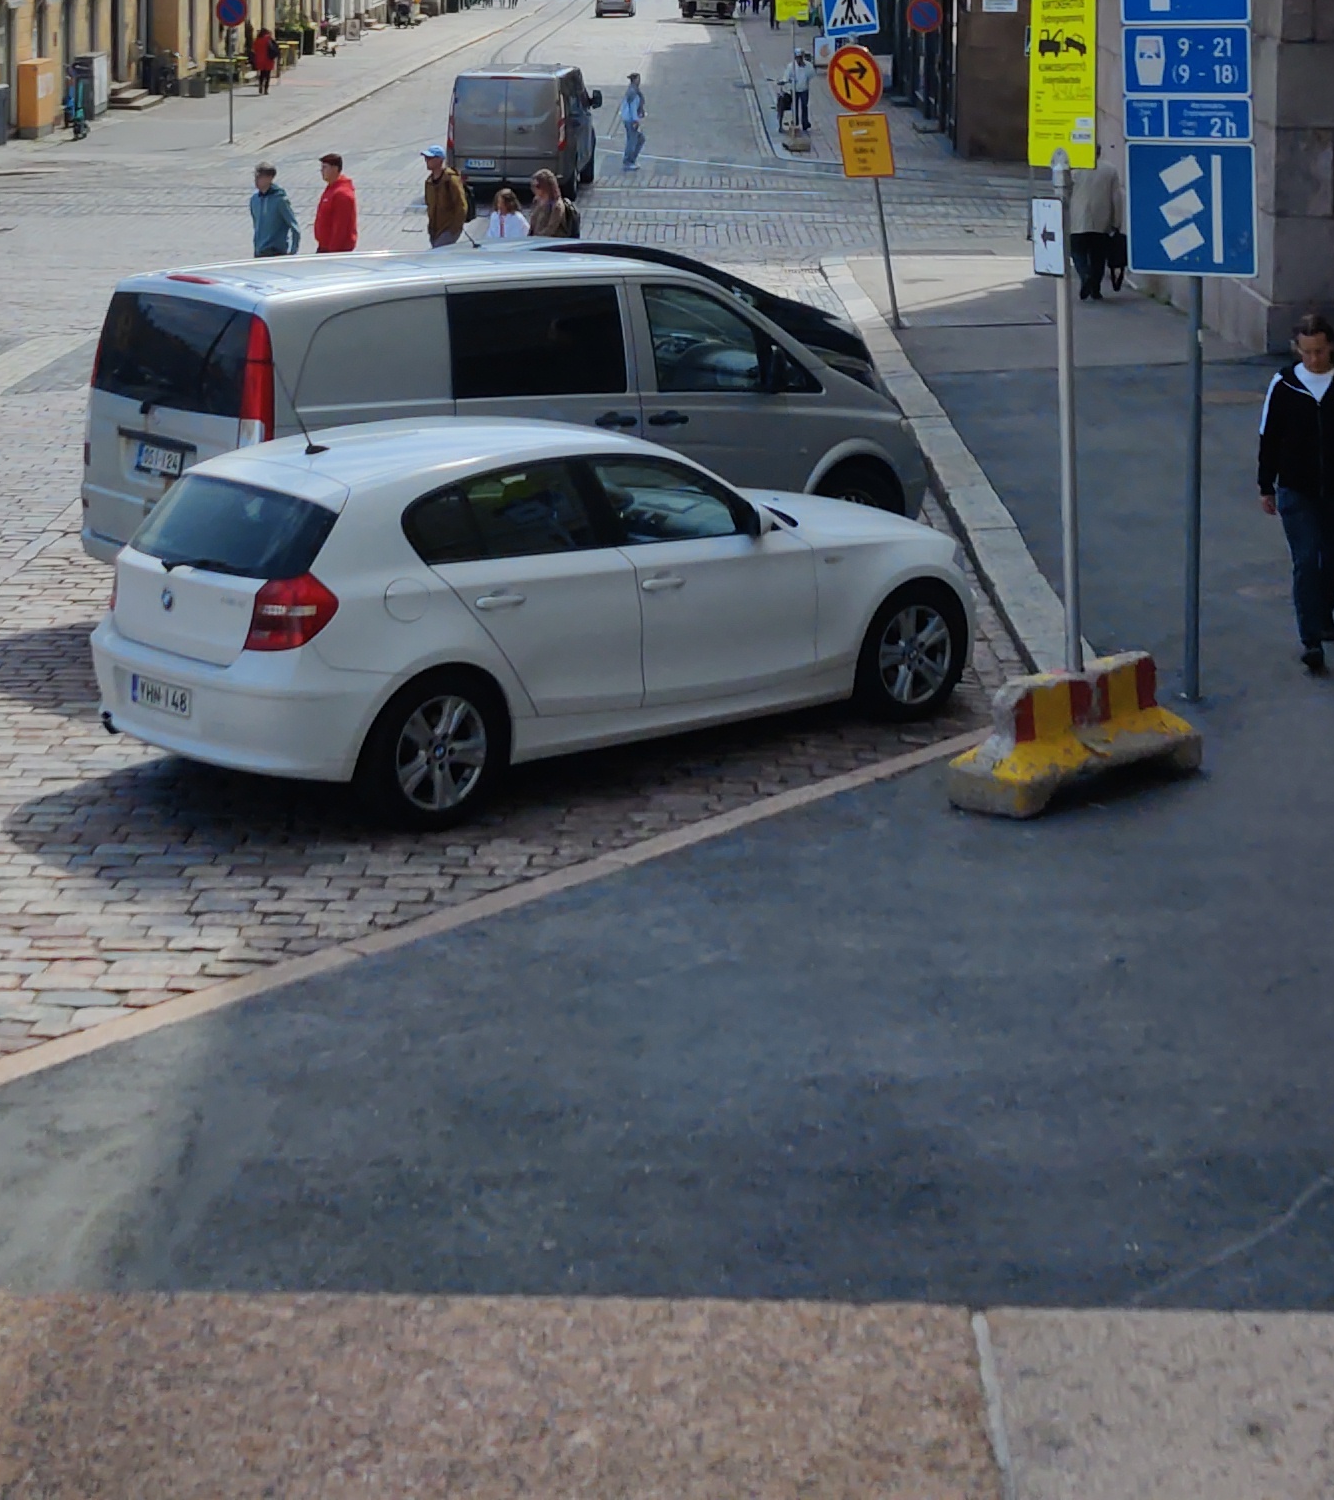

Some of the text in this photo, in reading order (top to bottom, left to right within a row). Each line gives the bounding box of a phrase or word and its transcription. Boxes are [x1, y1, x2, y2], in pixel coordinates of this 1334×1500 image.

[1177, 37, 1190, 57] 9
[1213, 37, 1232, 57] 21
[1172, 64, 1190, 84] (9
[1213, 64, 1239, 84] 18)
[1141, 116, 1150, 136] 1
